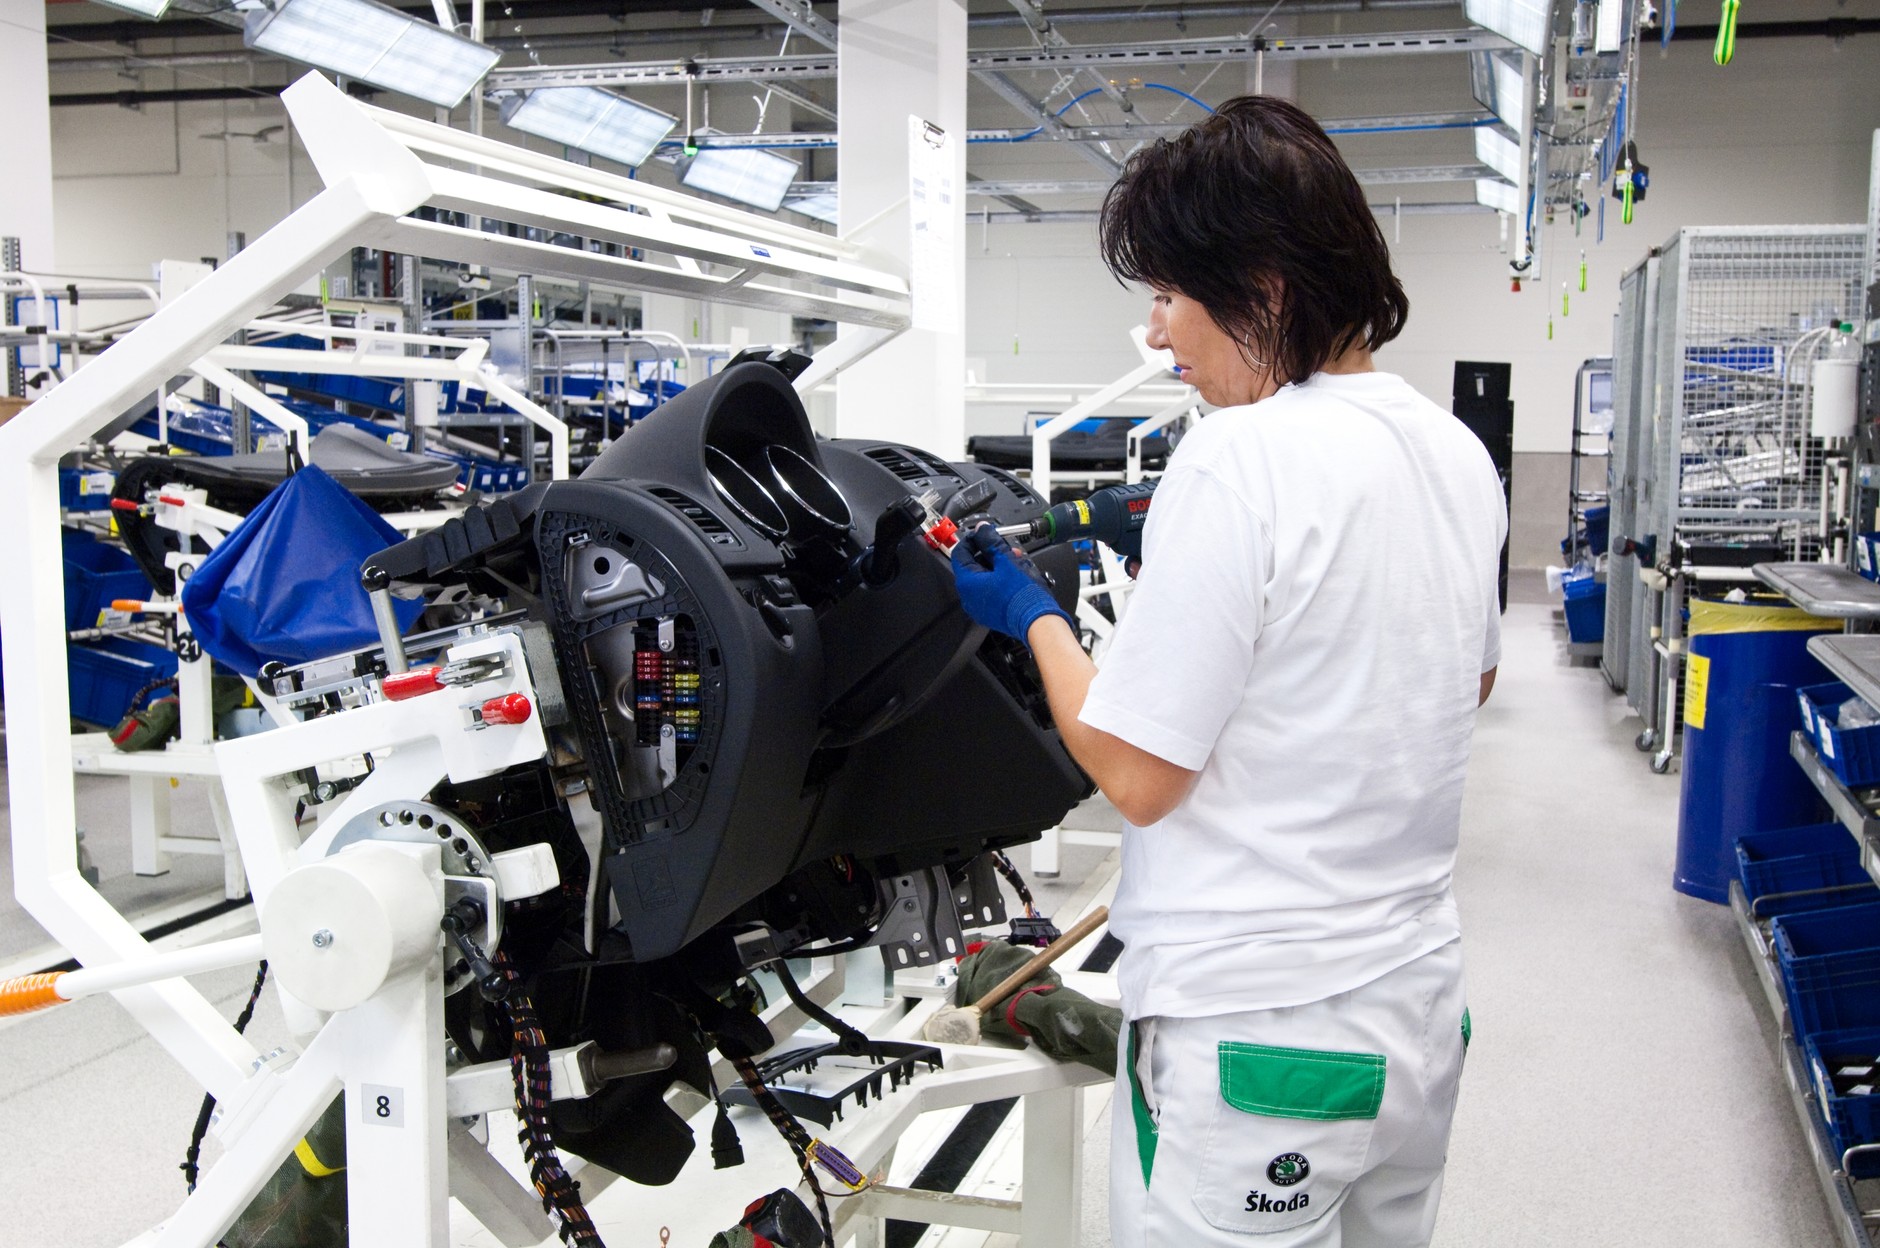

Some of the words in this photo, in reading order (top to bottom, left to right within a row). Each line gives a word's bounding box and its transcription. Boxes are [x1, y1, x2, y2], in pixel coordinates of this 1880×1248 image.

[180, 638, 199, 656] 21
[376, 1095, 391, 1118] 8
[1244, 1190, 1310, 1213] Škoda
